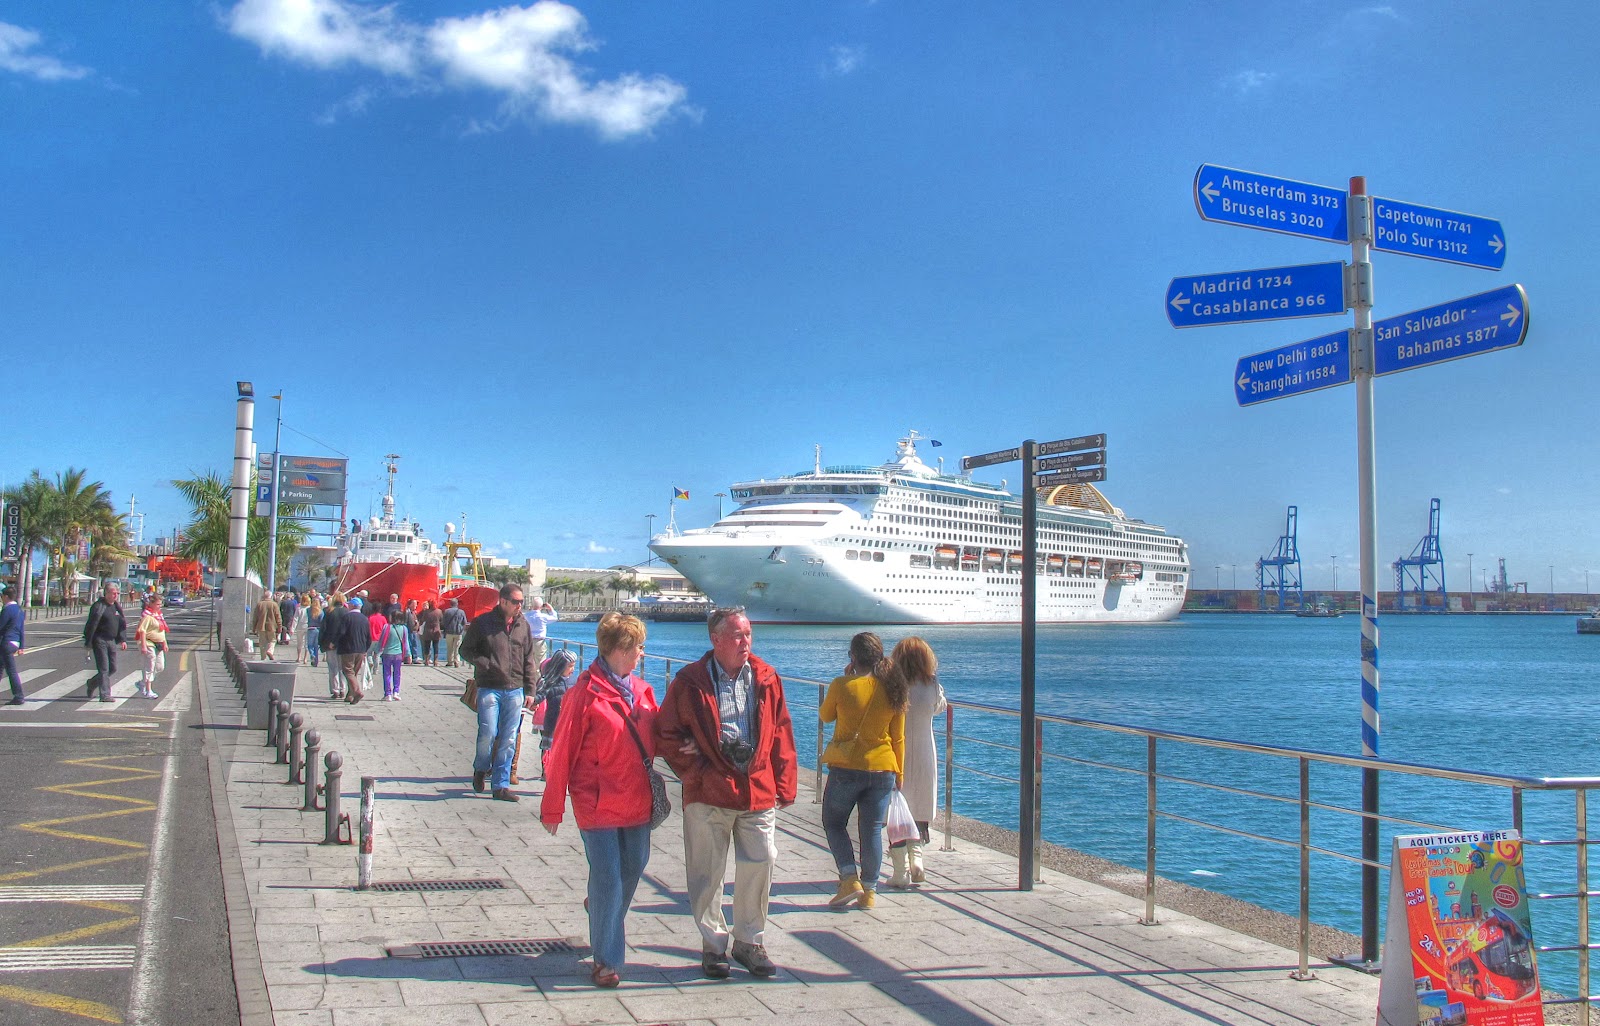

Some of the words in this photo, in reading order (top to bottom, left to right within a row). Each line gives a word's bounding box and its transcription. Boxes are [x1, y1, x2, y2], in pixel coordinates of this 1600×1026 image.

[1221, 175, 1307, 203] Amsterdam
[1311, 193, 1339, 209] 3173
[1222, 197, 1286, 222] Bruselas
[1290, 212, 1324, 229] 3020
[1376, 204, 1443, 229] Capetown
[1446, 219, 1471, 234] 7741
[1377, 226, 1407, 244] Polo
[1411, 232, 1434, 248] Sur
[1437, 240, 1468, 254] 13112
[1192, 276, 1251, 295] Madrid
[1257, 275, 1292, 289] 1734
[1192, 297, 1289, 316] Casablanca
[1295, 294, 1326, 308] 966
[1377, 326, 1400, 341] San
[1405, 308, 1467, 335] Salvador
[1250, 359, 1274, 374] New
[1277, 347, 1307, 367] Delhi
[1310, 341, 1339, 359] 8803
[1397, 334, 1461, 360] Bahamas
[1466, 325, 1498, 344] 5877
[1251, 369, 1302, 395] Shanghai
[1305, 364, 1336, 382] 11584
[288, 491, 313, 499] Parking
[8, 506, 19, 556] GUESS
[1438, 834, 1479, 844] TICKETS
[1482, 832, 1507, 841] HERE
[1454, 861, 1477, 875] Tour
